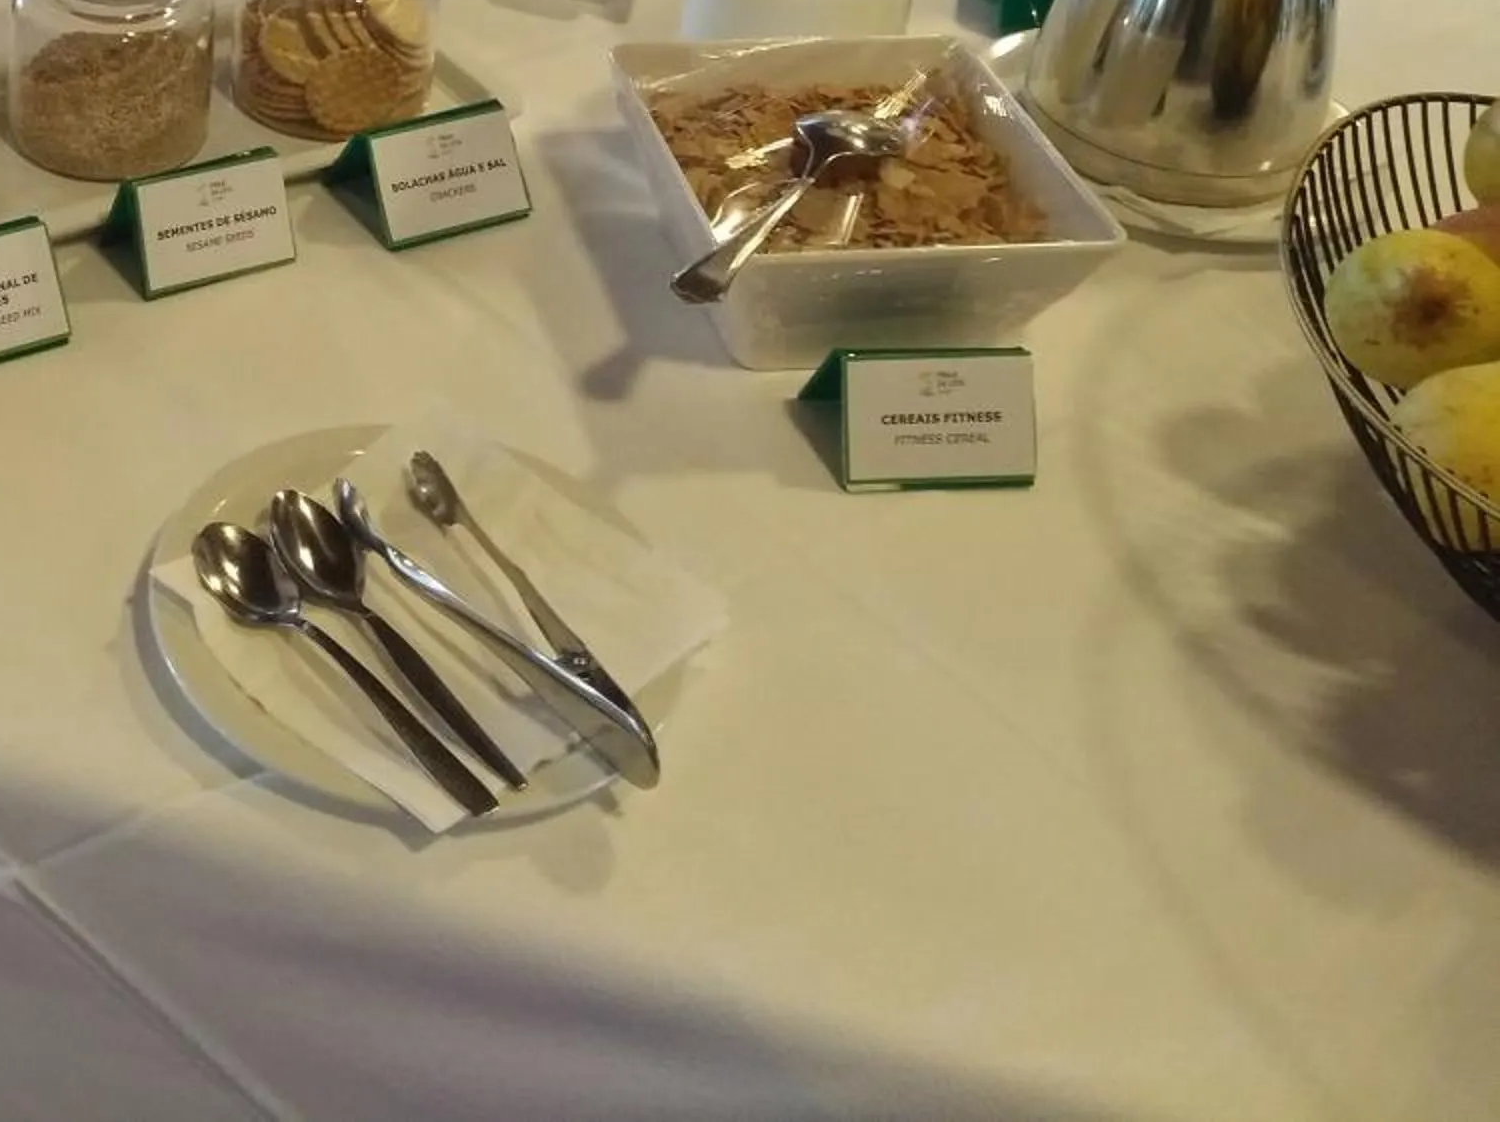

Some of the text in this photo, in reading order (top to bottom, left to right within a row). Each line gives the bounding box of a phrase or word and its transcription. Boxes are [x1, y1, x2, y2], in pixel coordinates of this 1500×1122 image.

[391, 171, 446, 193] BOLACHAS
[478, 161, 485, 173] E
[487, 157, 507, 171] SAL
[157, 218, 214, 241] SEMENTES
[215, 214, 231, 228] DE
[21, 272, 39, 286] DE
[881, 410, 1004, 426] CEREAIS FITNESS
